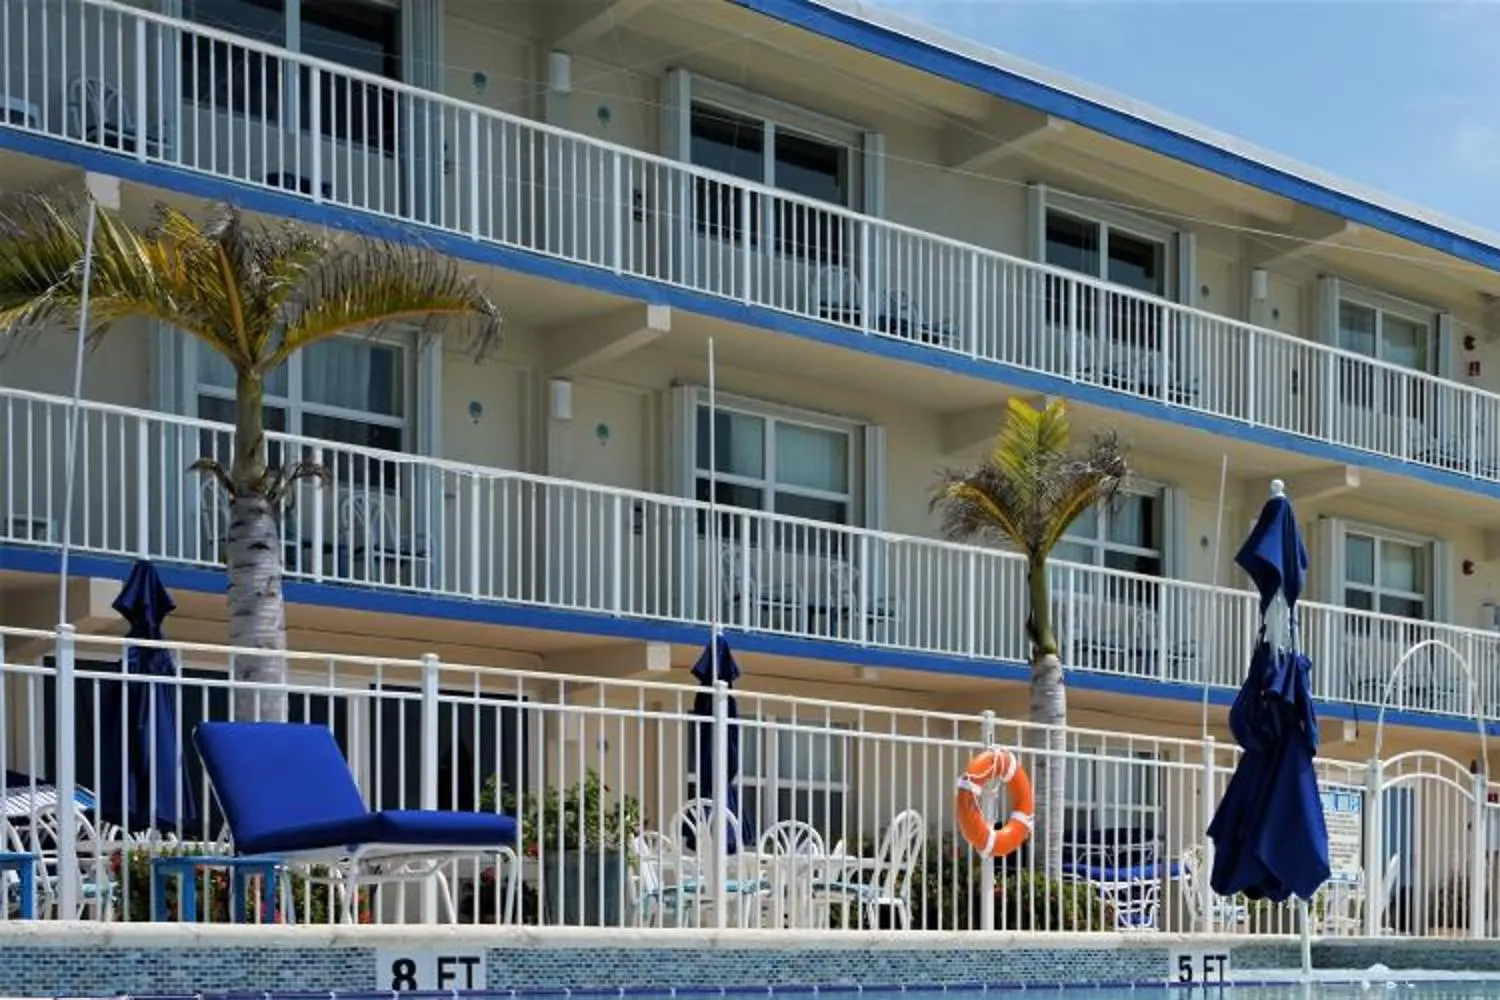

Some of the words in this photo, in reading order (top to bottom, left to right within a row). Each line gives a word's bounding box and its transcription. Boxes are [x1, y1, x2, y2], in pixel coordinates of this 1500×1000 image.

[392, 957, 417, 991] 8
[437, 956, 480, 991] FT
[1179, 955, 1192, 983] 5
[1204, 955, 1227, 983] FT
